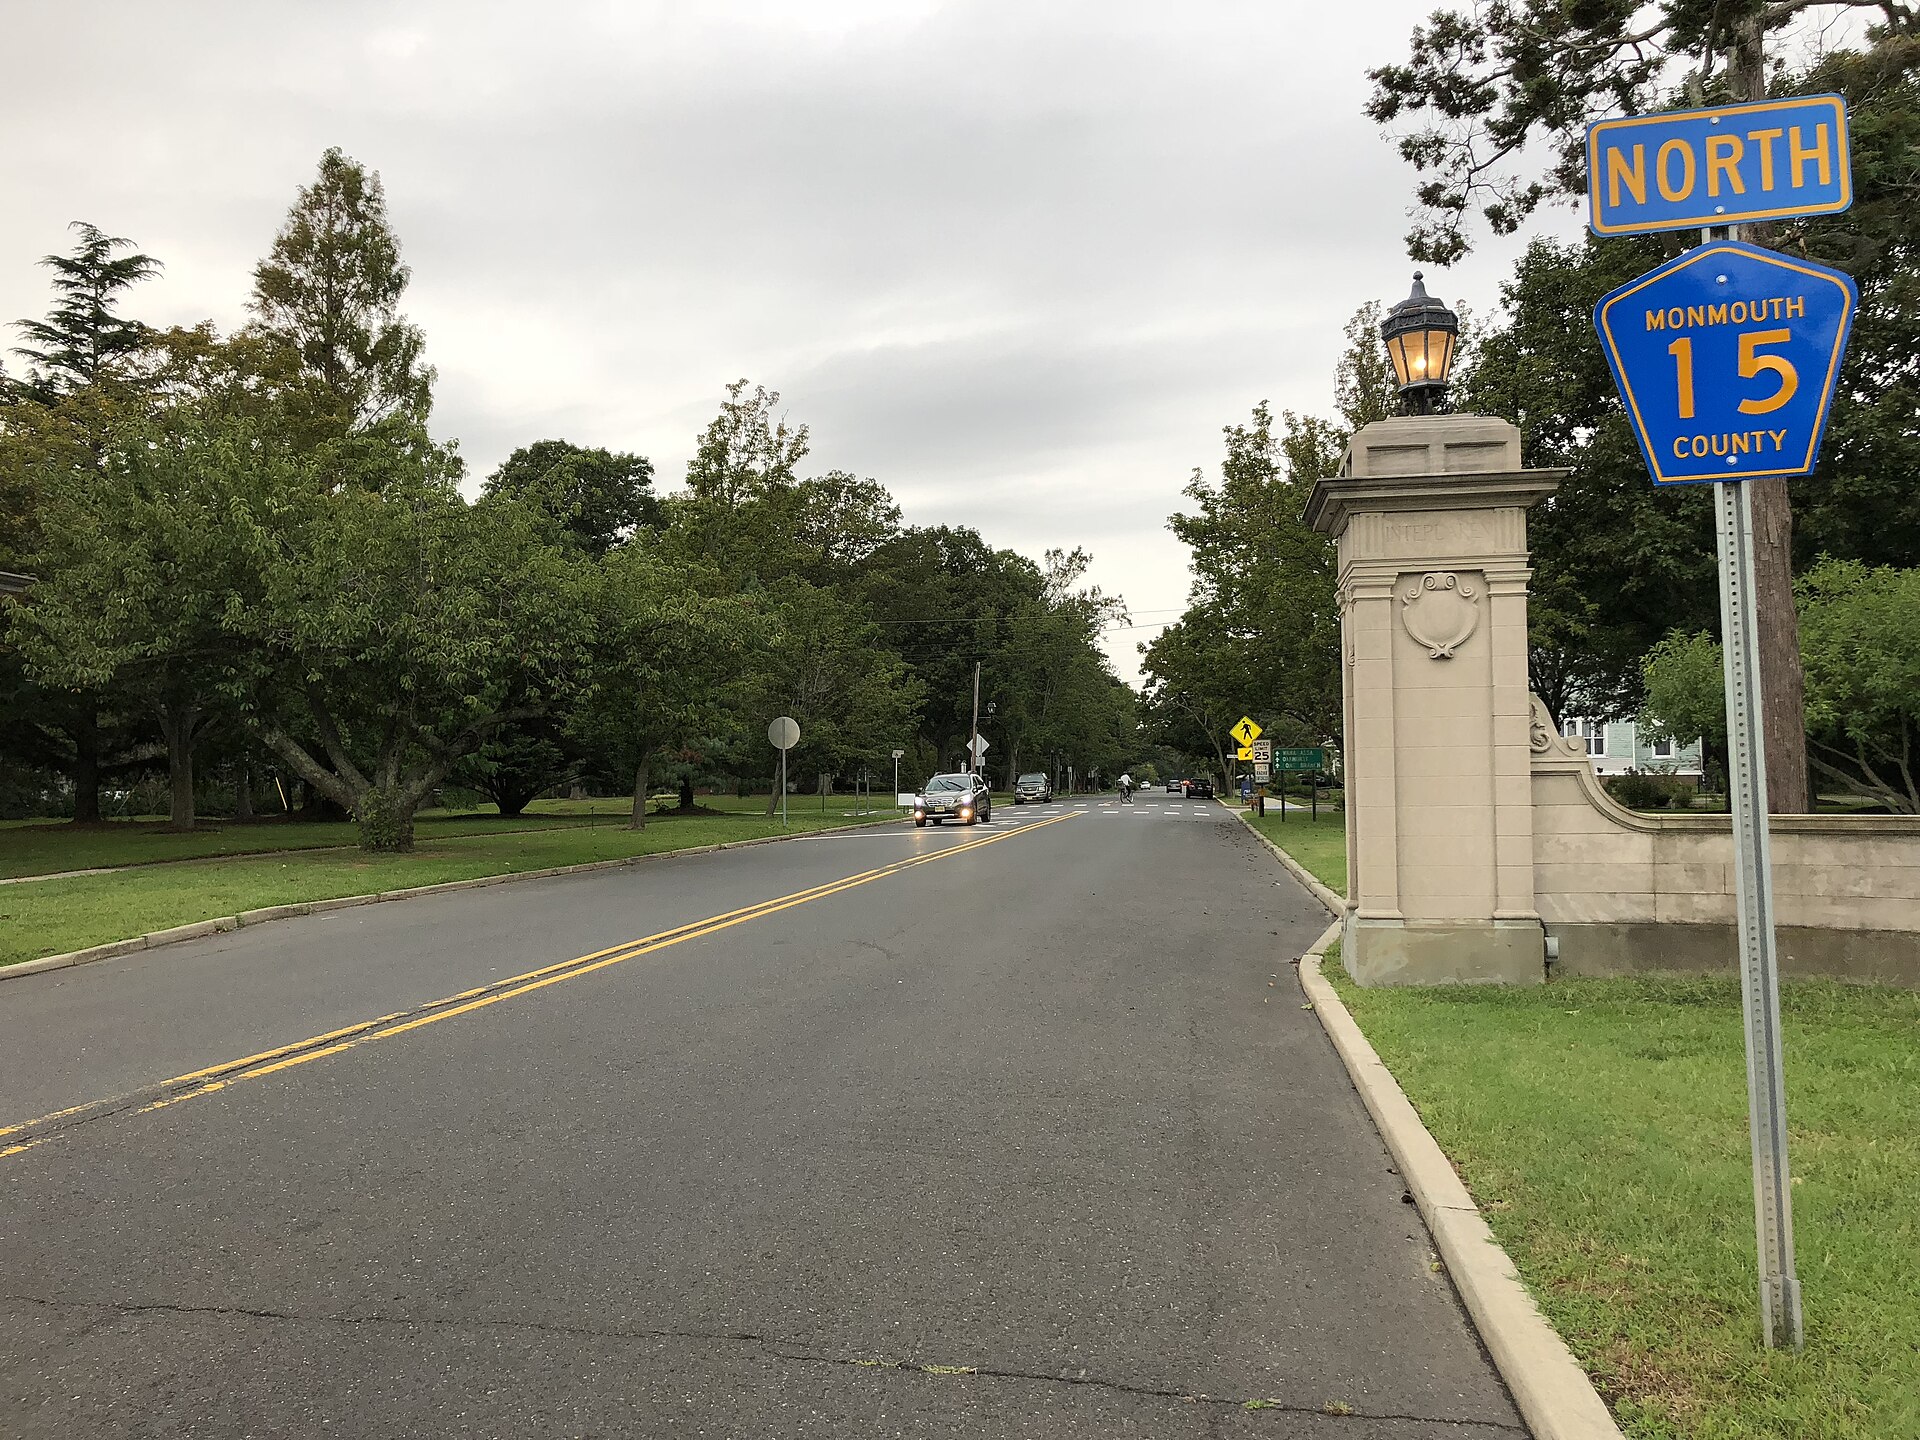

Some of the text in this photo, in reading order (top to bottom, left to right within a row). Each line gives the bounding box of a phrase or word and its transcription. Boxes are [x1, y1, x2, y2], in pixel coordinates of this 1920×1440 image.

[1606, 122, 1831, 207] NORTH
[1645, 296, 1805, 331] MONMOUTH
[1673, 428, 1788, 460] COUNTY
[1384, 521, 1492, 543] INTERLKEN
[1254, 752, 1269, 760] 25
